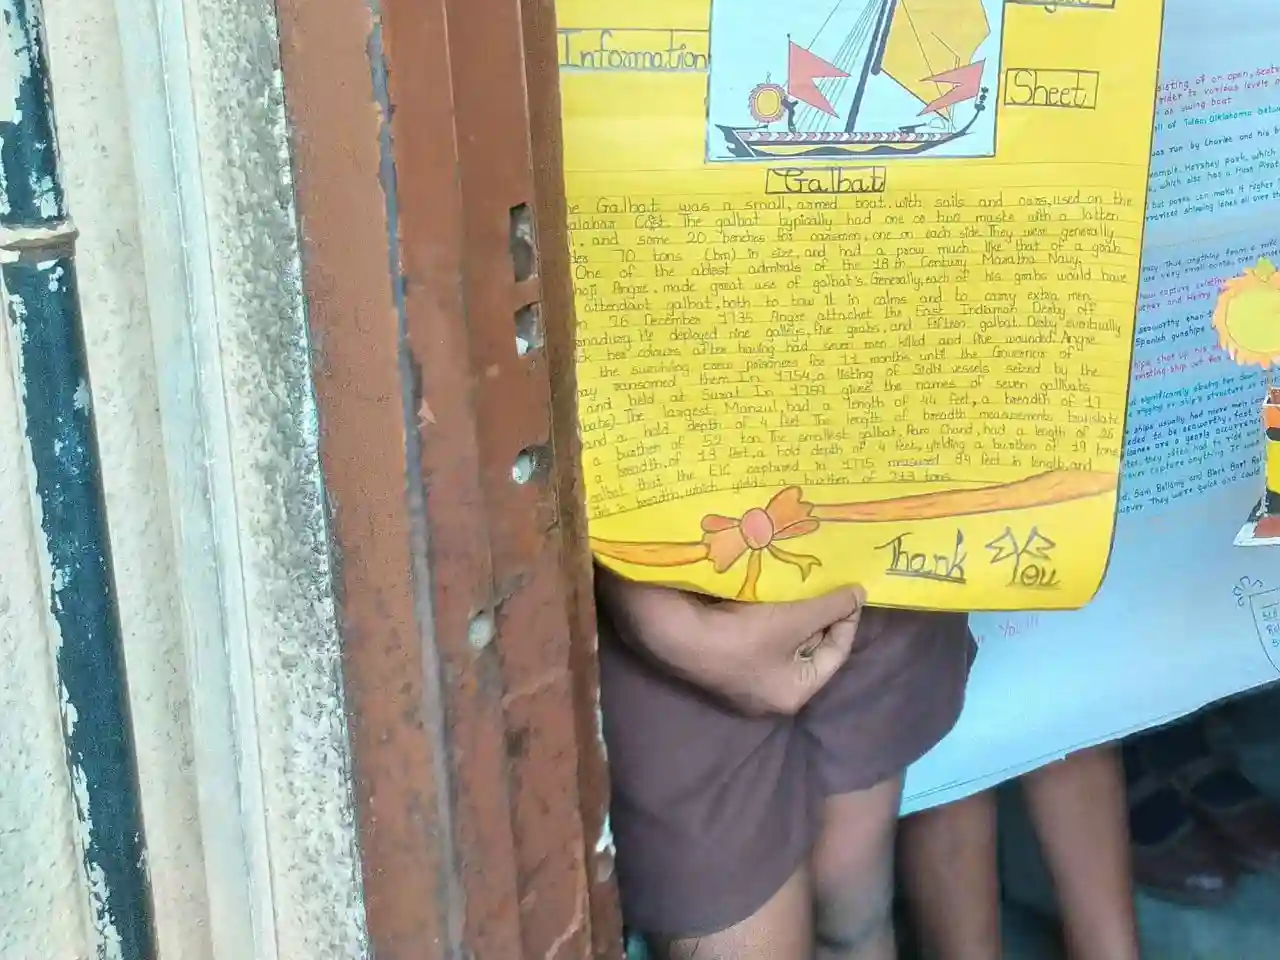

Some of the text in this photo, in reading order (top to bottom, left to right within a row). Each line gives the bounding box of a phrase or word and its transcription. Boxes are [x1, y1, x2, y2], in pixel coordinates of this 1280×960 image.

[560, 31, 709, 71] Information
[1010, 69, 1087, 109] Sheet
[771, 167, 885, 192] Galbat
[596, 196, 660, 213] Galbat
[678, 203, 709, 211] was
[896, 194, 922, 208] with
[934, 193, 964, 208] sails
[978, 191, 1003, 207] and
[1113, 191, 1133, 206] the
[679, 213, 703, 227] The
[716, 212, 761, 233] galbat
[779, 212, 832, 231] typically
[847, 211, 871, 224] had
[592, 232, 619, 246] and
[686, 232, 706, 244] 20
[1061, 224, 1114, 244] generally
[612, 249, 636, 262] 70
[805, 243, 825, 258] and
[938, 241, 969, 254] much
[576, 266, 602, 279] One
[619, 265, 636, 278] of
[654, 266, 674, 277] the
[664, 278, 697, 292] made
[1058, 268, 1091, 281] would
[644, 313, 701, 326] December
[874, 529, 967, 580] Thank
